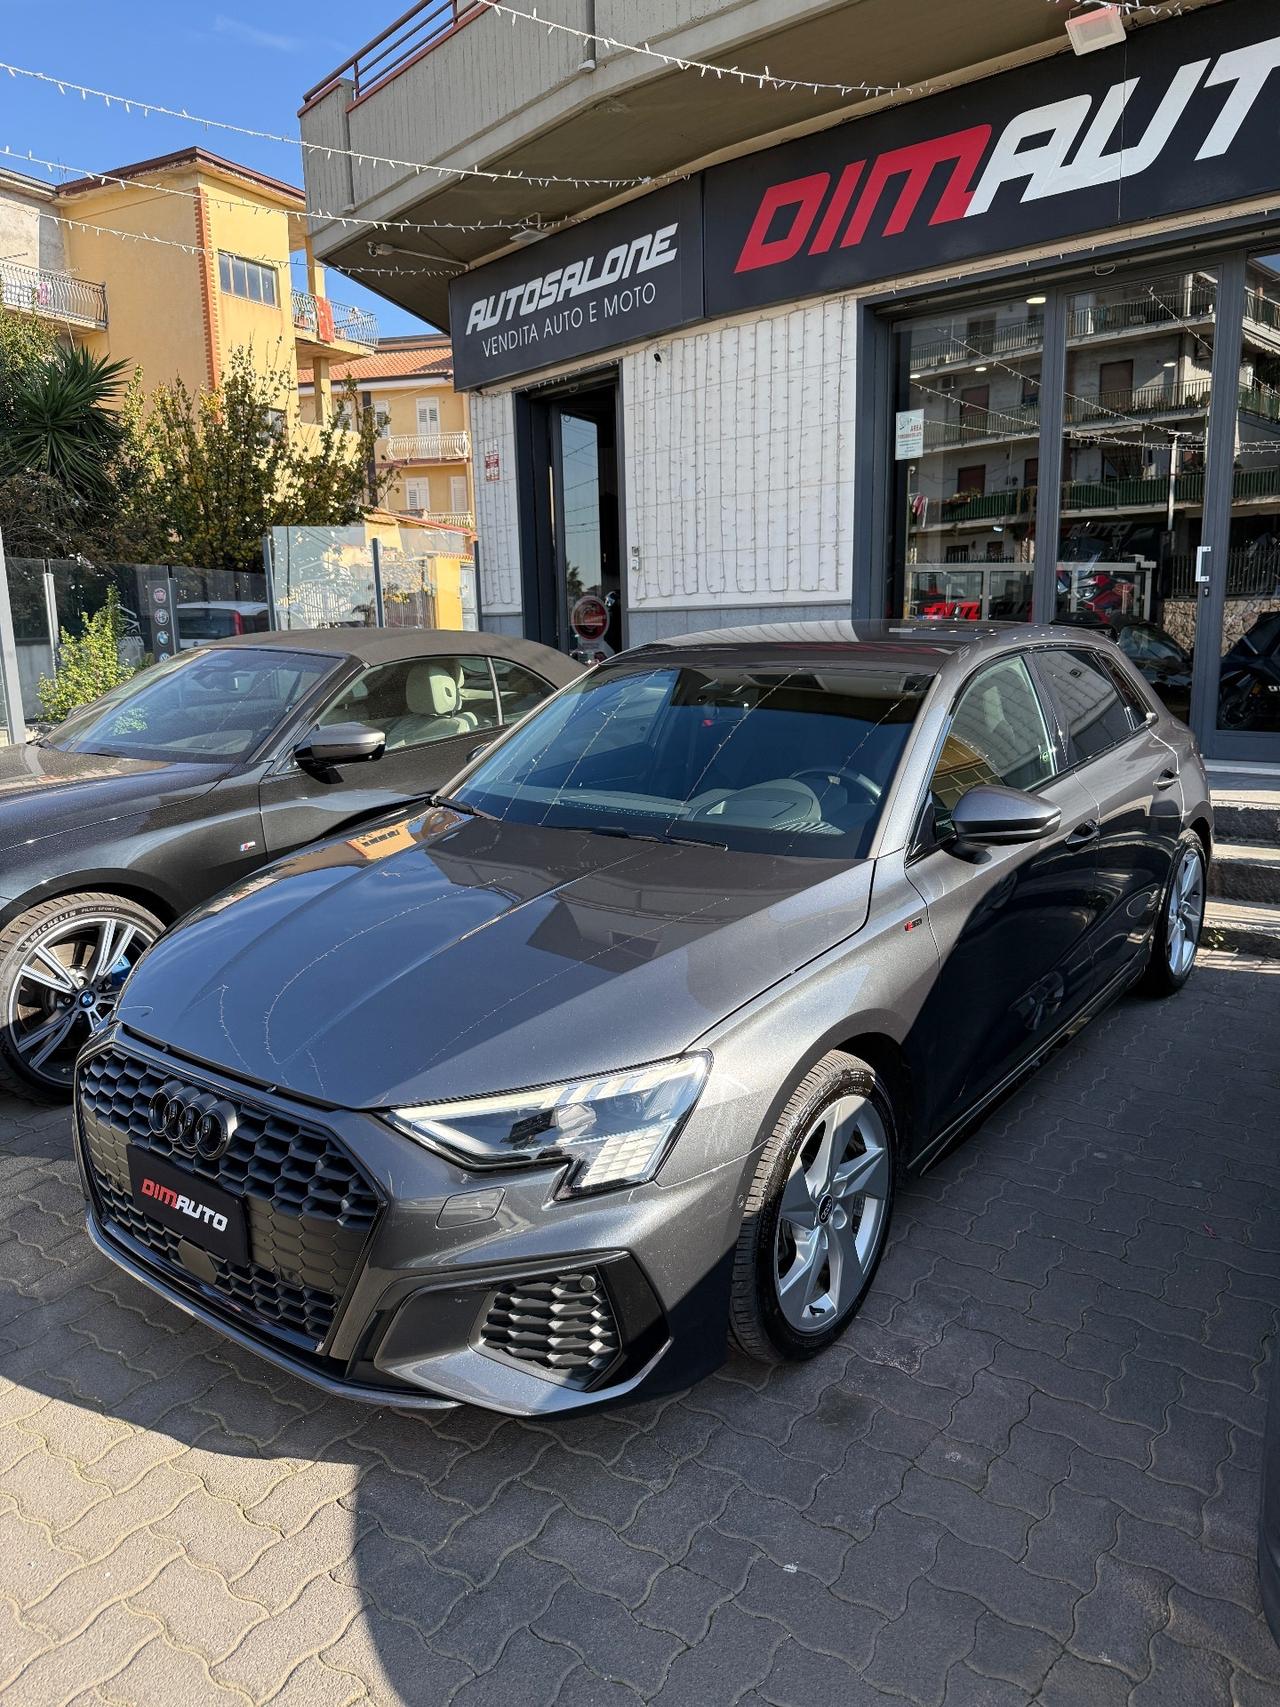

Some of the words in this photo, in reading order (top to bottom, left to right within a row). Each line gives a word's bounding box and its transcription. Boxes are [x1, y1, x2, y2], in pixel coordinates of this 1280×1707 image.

[465, 222, 678, 335] AUTOSALONE
[482, 322, 539, 358] VENDITA
[543, 307, 583, 339] AUTO
[589, 301, 598, 323] E
[604, 281, 656, 319] MOTO
[30, 910, 76, 942] MICHELIN
[141, 1178, 228, 1232] DIMAUTO
